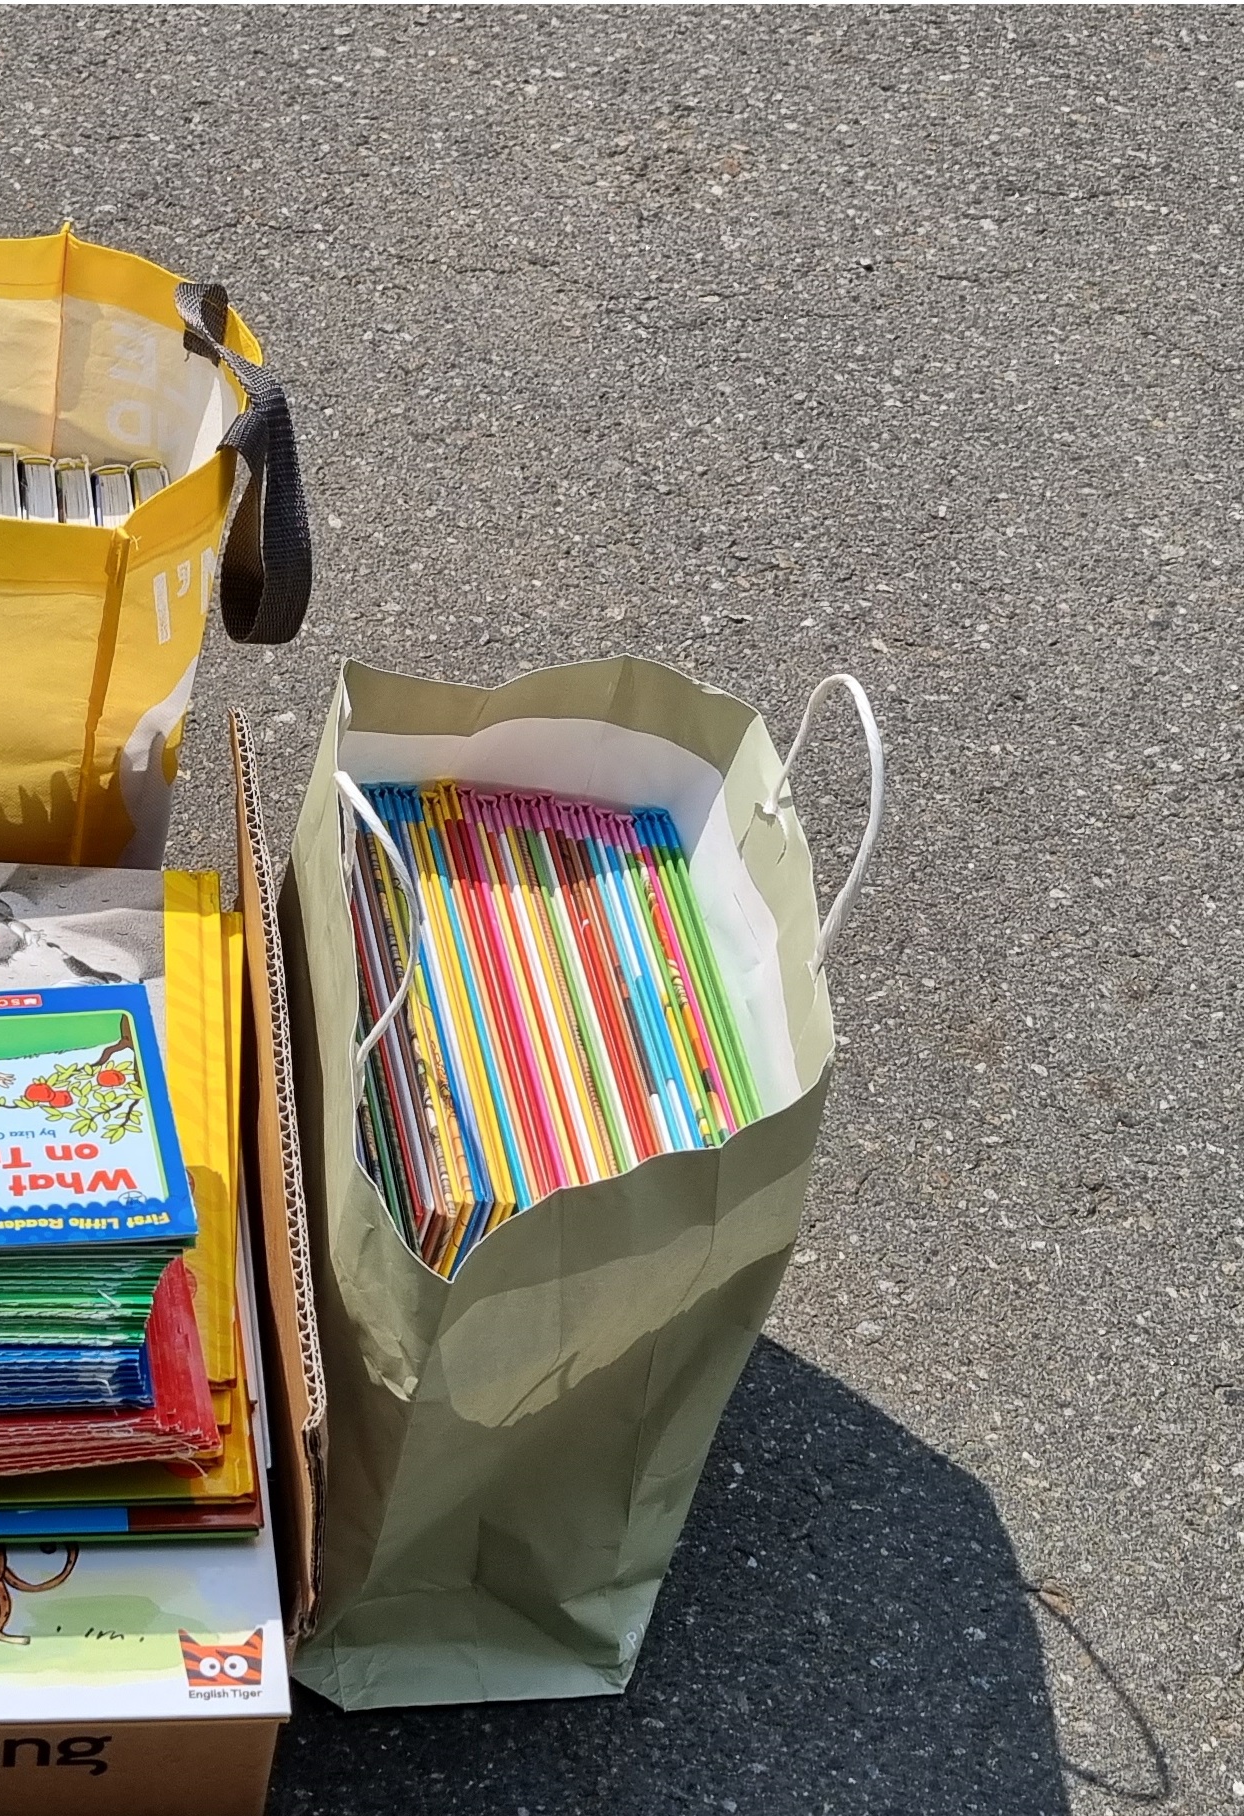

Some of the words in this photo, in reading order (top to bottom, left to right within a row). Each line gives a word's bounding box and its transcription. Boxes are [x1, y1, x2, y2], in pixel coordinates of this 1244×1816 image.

[9, 1130, 35, 1141] Liza
[40, 1128, 57, 1140] by
[45, 1142, 100, 1165] on
[8, 1168, 138, 1198] What
[68, 1217, 120, 1230] Little
[126, 1212, 171, 1230] First
[189, 1689, 229, 1700] English
[231, 1689, 263, 1699] Tiger
